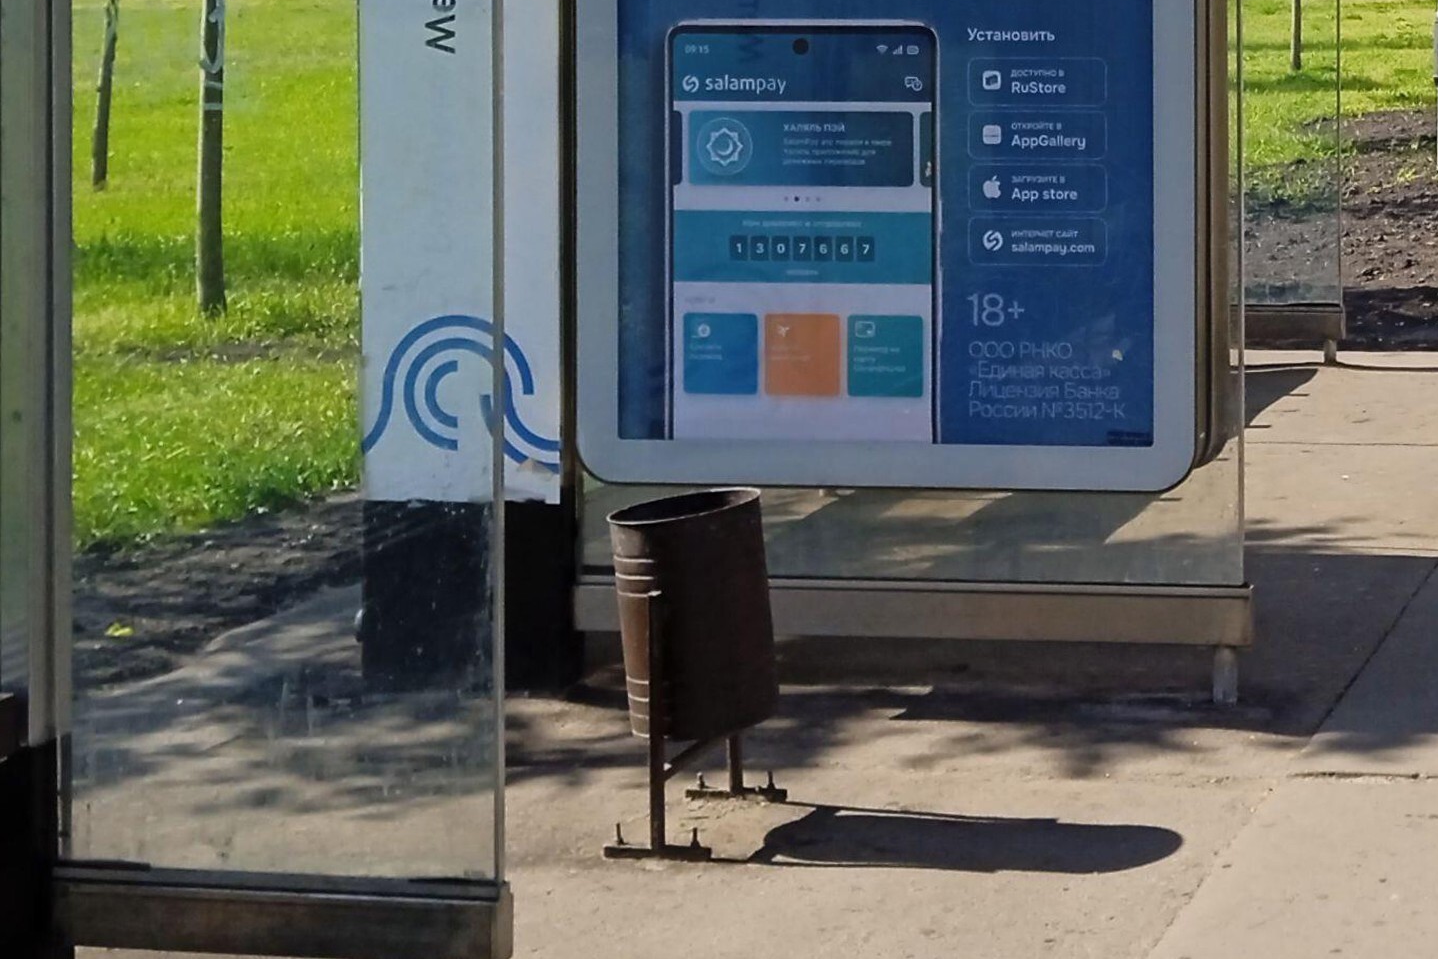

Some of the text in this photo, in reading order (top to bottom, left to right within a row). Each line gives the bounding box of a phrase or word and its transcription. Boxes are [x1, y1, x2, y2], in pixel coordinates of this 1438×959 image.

[967, 27, 1056, 43] Установить
[705, 74, 786, 95] salampay
[1011, 81, 1067, 94] RuStore
[1011, 134, 1086, 150] AppGallery
[1011, 187, 1078, 202] App store
[1011, 241, 1095, 256] salampay.com
[967, 293, 1025, 327] 18+
[968, 341, 1072, 359] ООО РНКО
[968, 381, 1119, 399] Лицензия Банка
[969, 401, 1037, 418] России
